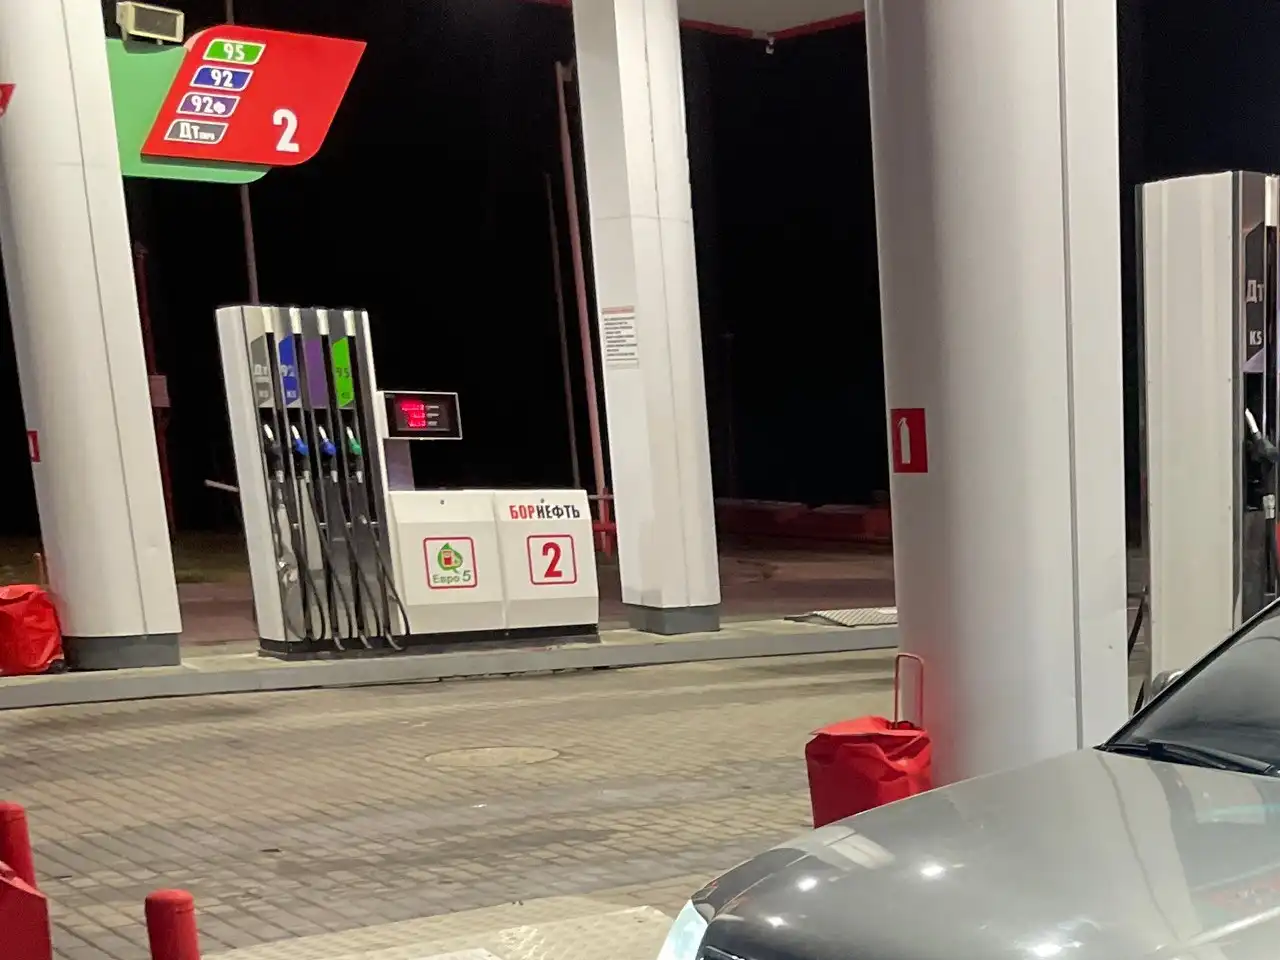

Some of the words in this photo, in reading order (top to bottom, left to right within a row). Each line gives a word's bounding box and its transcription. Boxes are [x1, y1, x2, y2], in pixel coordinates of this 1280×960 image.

[223, 43, 245, 60] 95
[211, 69, 233, 87] 92
[272, 108, 300, 153] 2
[509, 505, 580, 519] БОРНЕФТЬ
[542, 542, 563, 578] 2
[462, 570, 472, 582] 5
